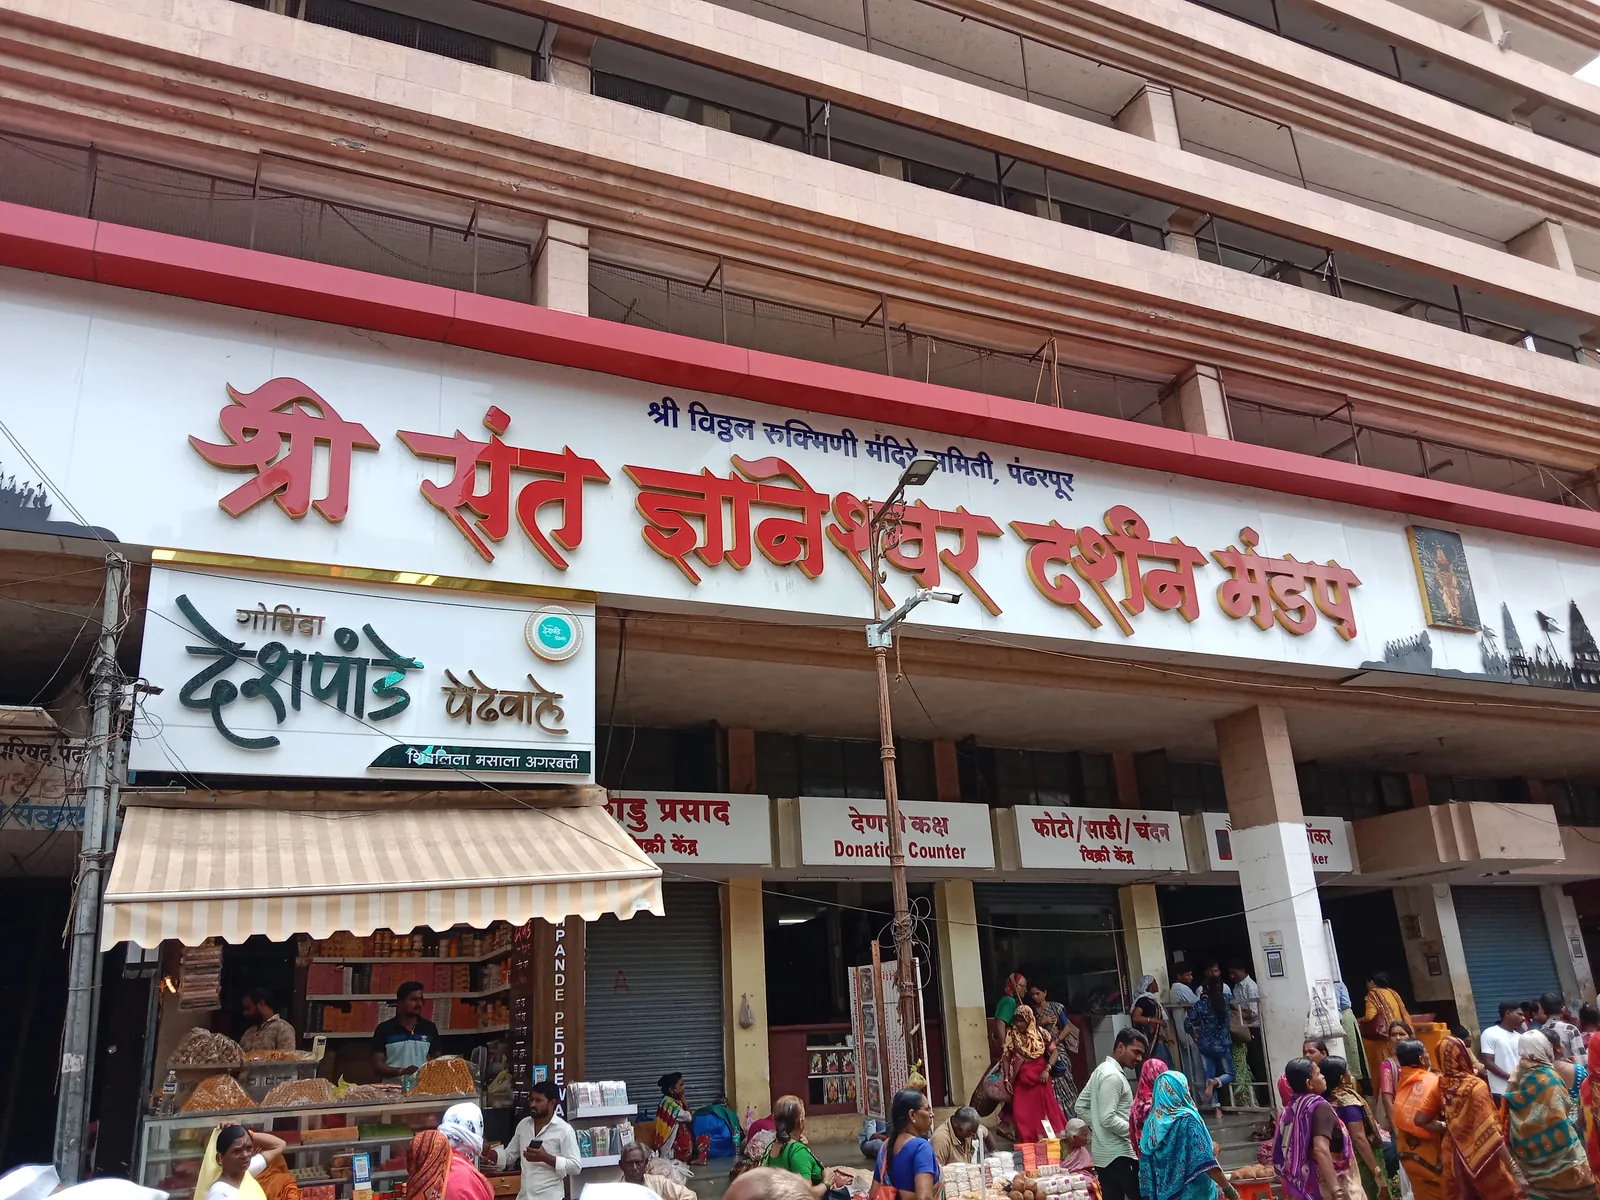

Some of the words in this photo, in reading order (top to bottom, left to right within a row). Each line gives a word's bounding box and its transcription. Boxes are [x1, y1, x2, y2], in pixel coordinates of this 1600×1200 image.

[647, 396, 680, 428] श्री
[688, 401, 755, 443] विठ्ठल
[762, 418, 858, 458] रुक्मिणी
[1006, 456, 1075, 502] पंढरपूर
[188, 377, 381, 523] श्री
[396, 405, 611, 571] संत
[622, 454, 1004, 617] ज्ञानेश्वर
[1008, 505, 1209, 637] दर्शन
[1210, 526, 1363, 642] मंडप
[175, 594, 425, 750] देशपांडे
[441, 668, 569, 734] पेढेवाले
[475, 754, 520, 767] मसाला
[525, 753, 579, 770] अगरबत्ती
[656, 799, 730, 826] प्रसाद
[848, 806, 906, 834] देणी
[908, 815, 949, 837] कक्ष
[670, 833, 698, 856] केंद्र
[1305, 822, 1333, 845] ॉकर
[834, 840, 892, 858] Donatio
[908, 841, 966, 860] Counter
[1079, 845, 1110, 862] विक्री
[1112, 845, 1135, 864] केंद्र
[1311, 852, 1328, 864] ker
